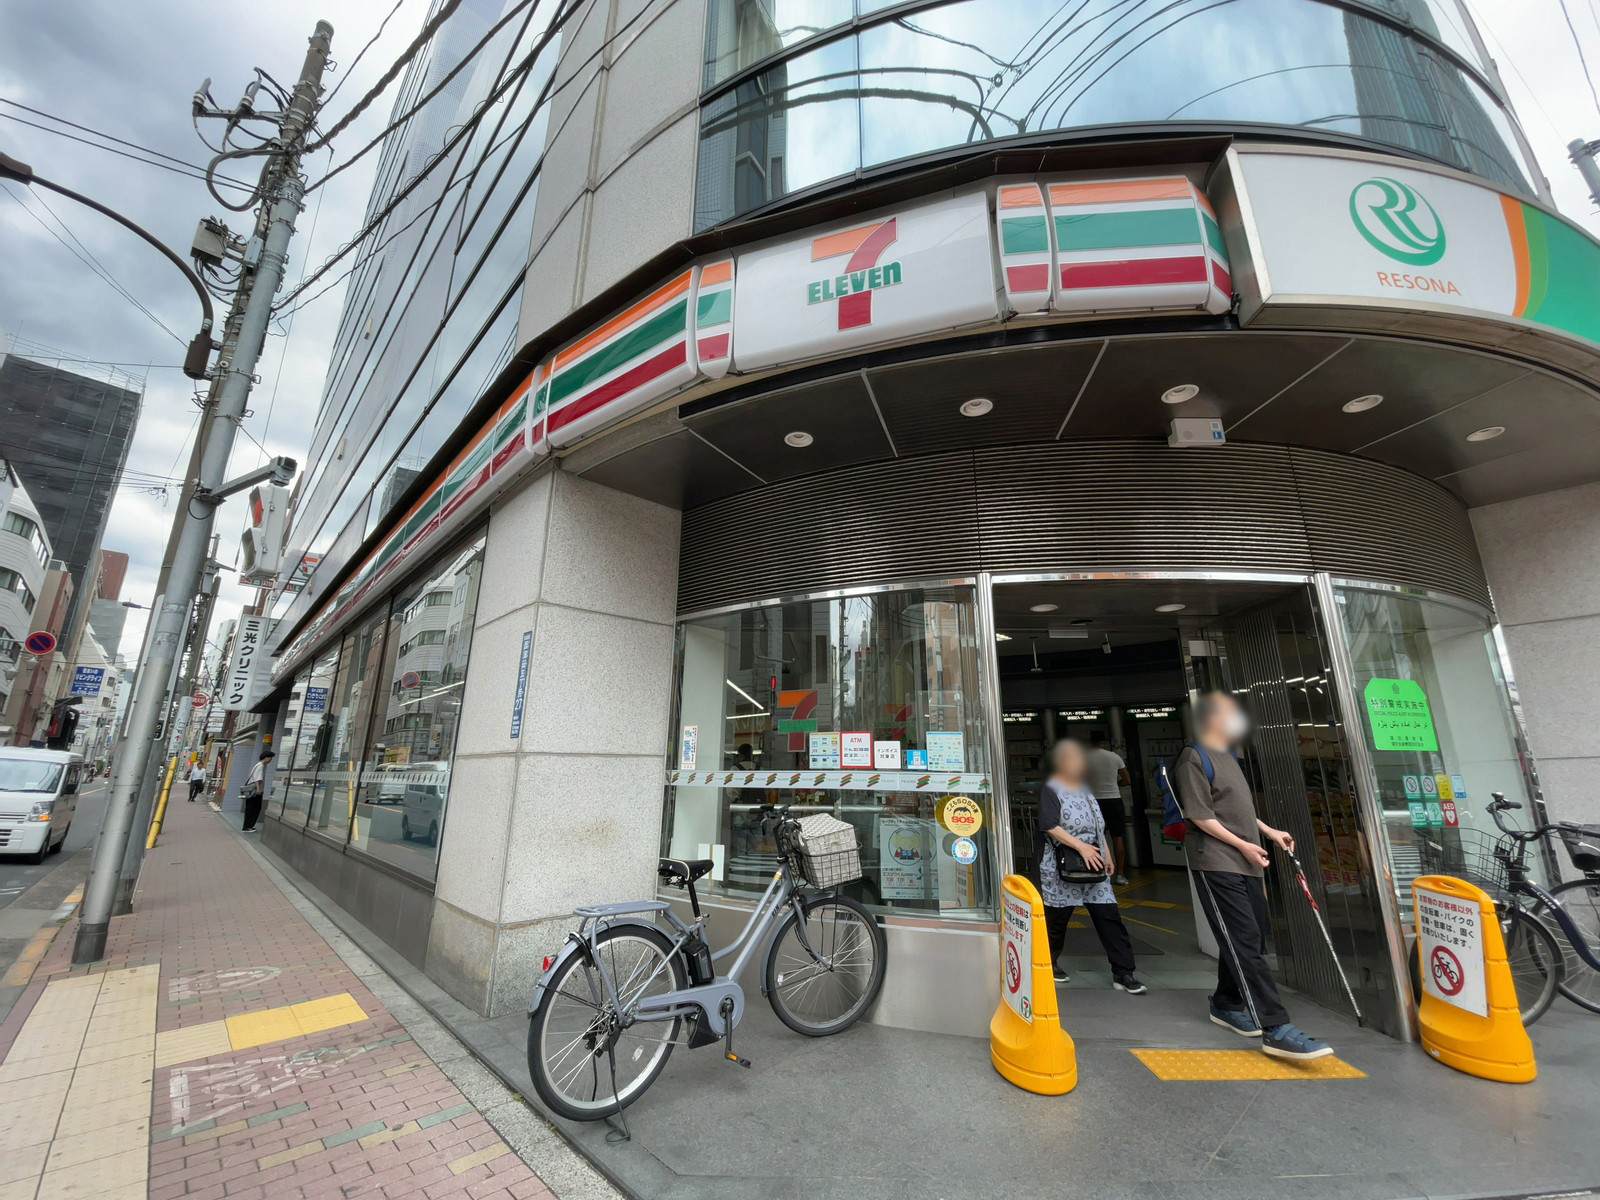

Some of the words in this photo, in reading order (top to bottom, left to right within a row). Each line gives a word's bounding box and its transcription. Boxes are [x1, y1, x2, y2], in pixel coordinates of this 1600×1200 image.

[1376, 271, 1462, 296] RESONA
[229, 620, 260, 704] 三光クリニック
[951, 815, 975, 824] SOS
[1420, 905, 1474, 927] の自転車・バイクの
